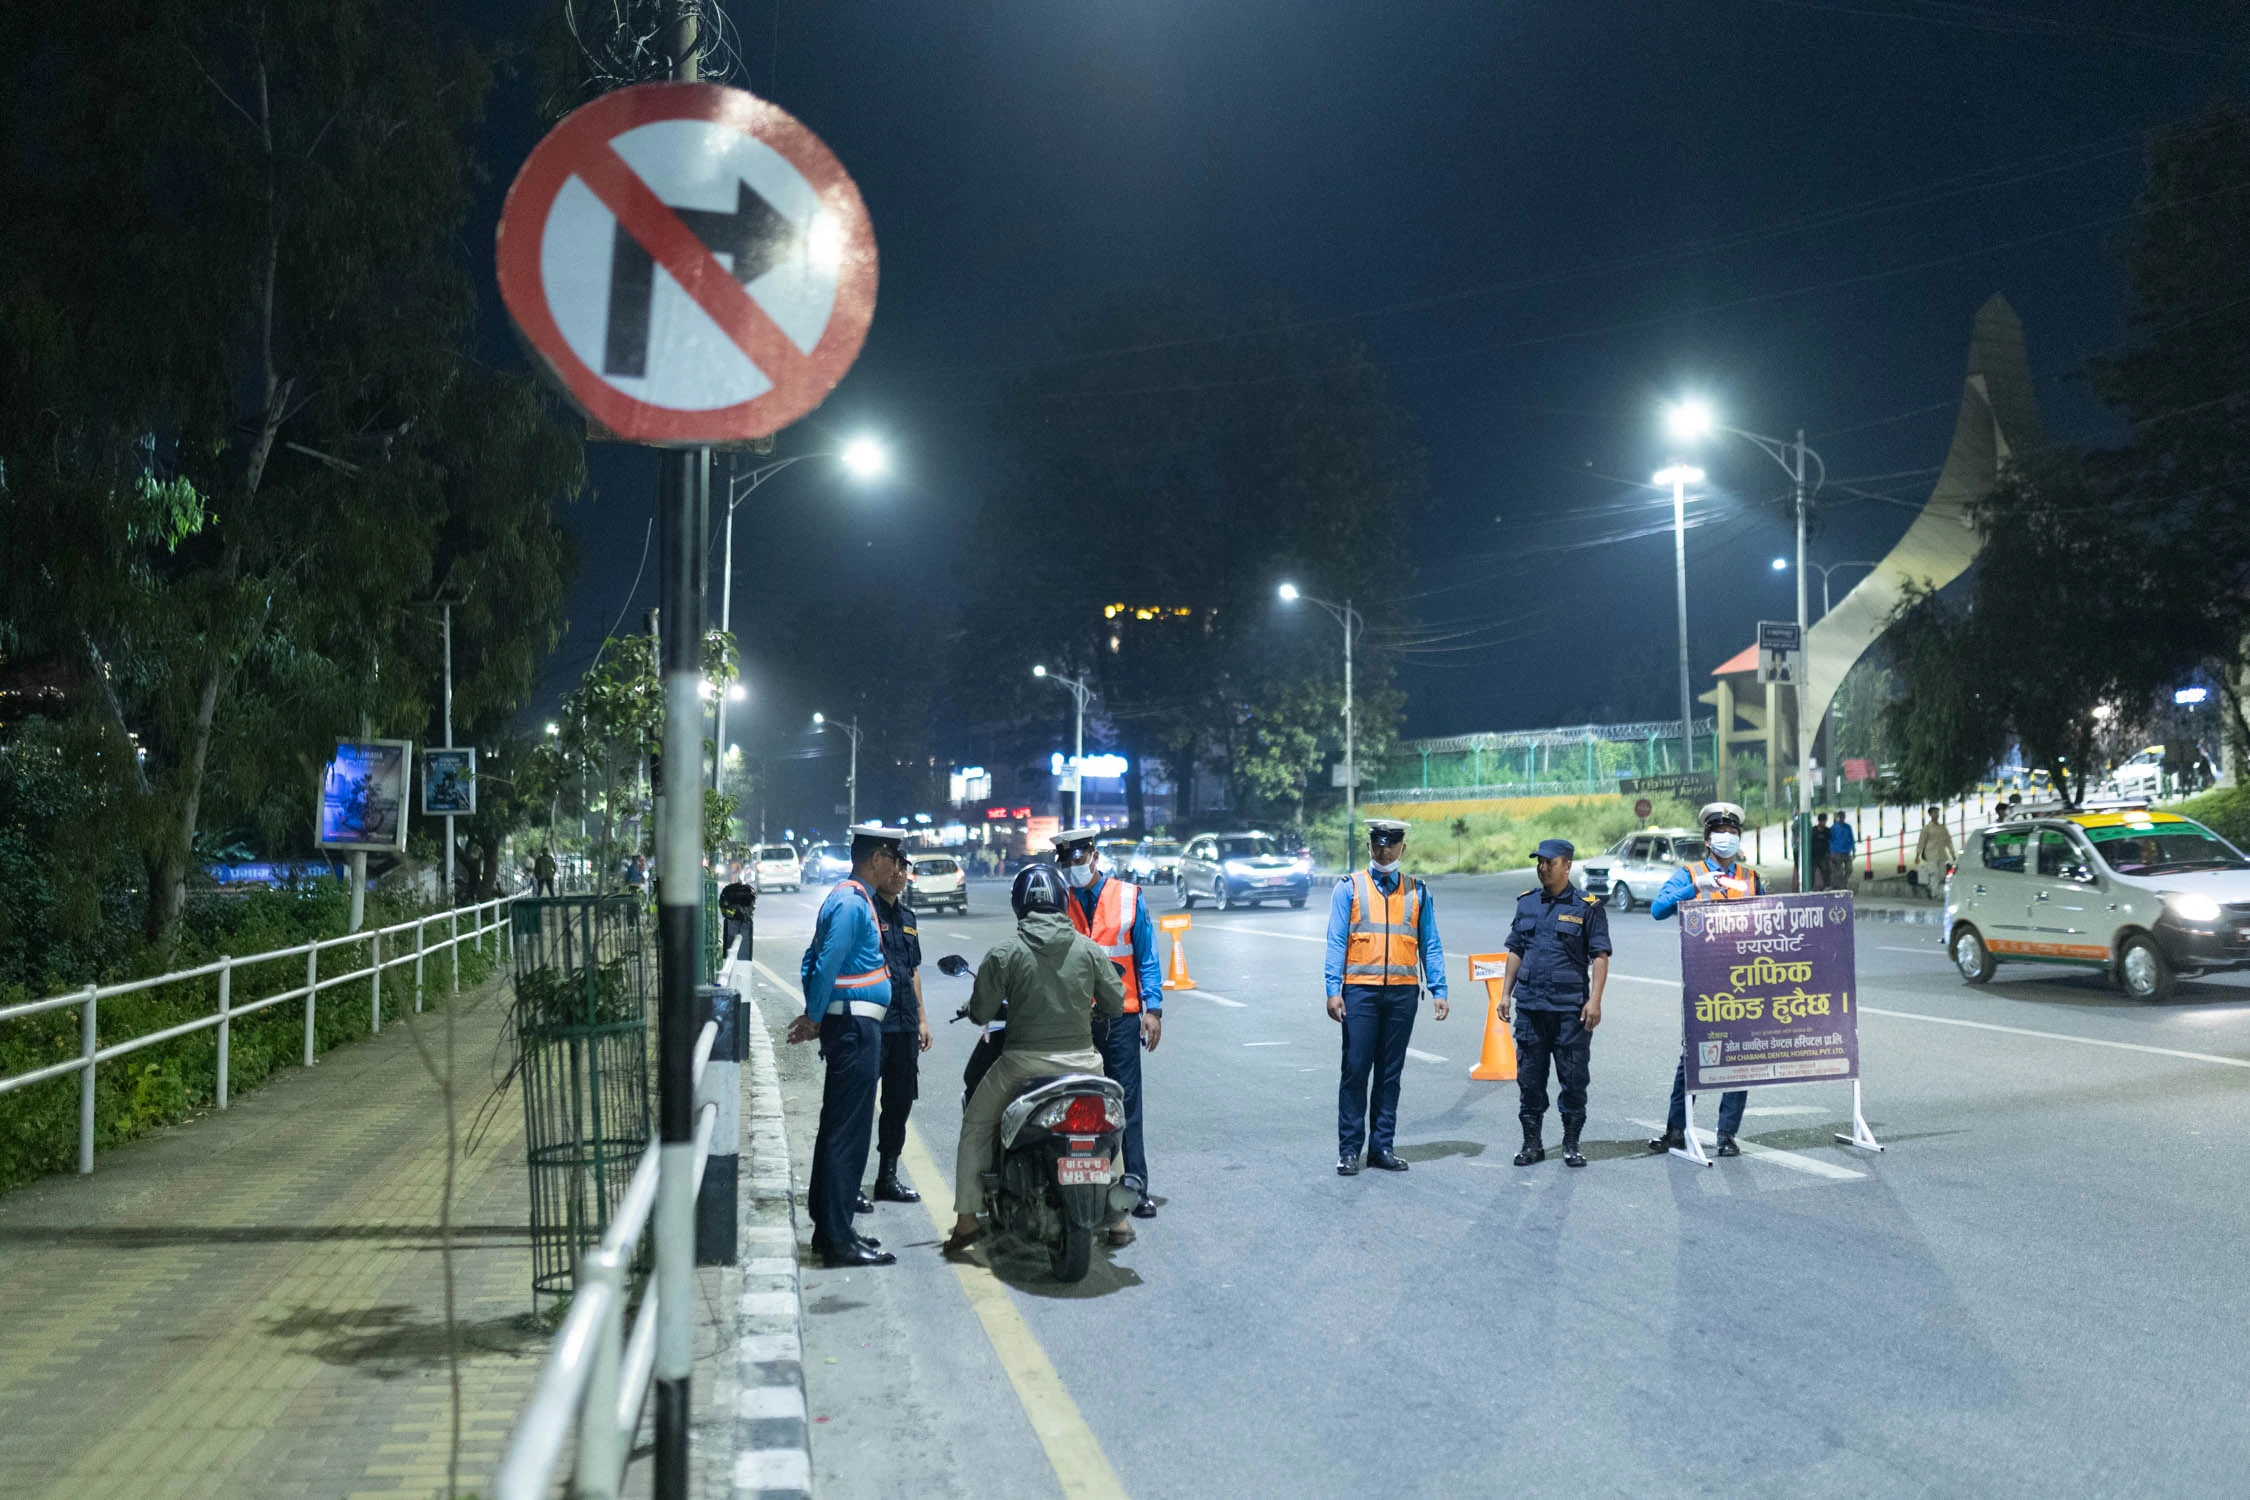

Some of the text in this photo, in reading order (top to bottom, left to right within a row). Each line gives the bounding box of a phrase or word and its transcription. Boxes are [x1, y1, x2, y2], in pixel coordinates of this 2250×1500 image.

[1704, 902, 1825, 943] ट्राफिक प्रहरी प्रभाग
[1735, 933, 1805, 954] एयरपोर्ट
[1729, 956, 1813, 993] ट्राफिक
[1695, 992, 1765, 1022] चेकिङ
[1768, 1051, 1790, 1060] DENTAL
[1791, 1050, 1820, 1058] HOSPITAL
